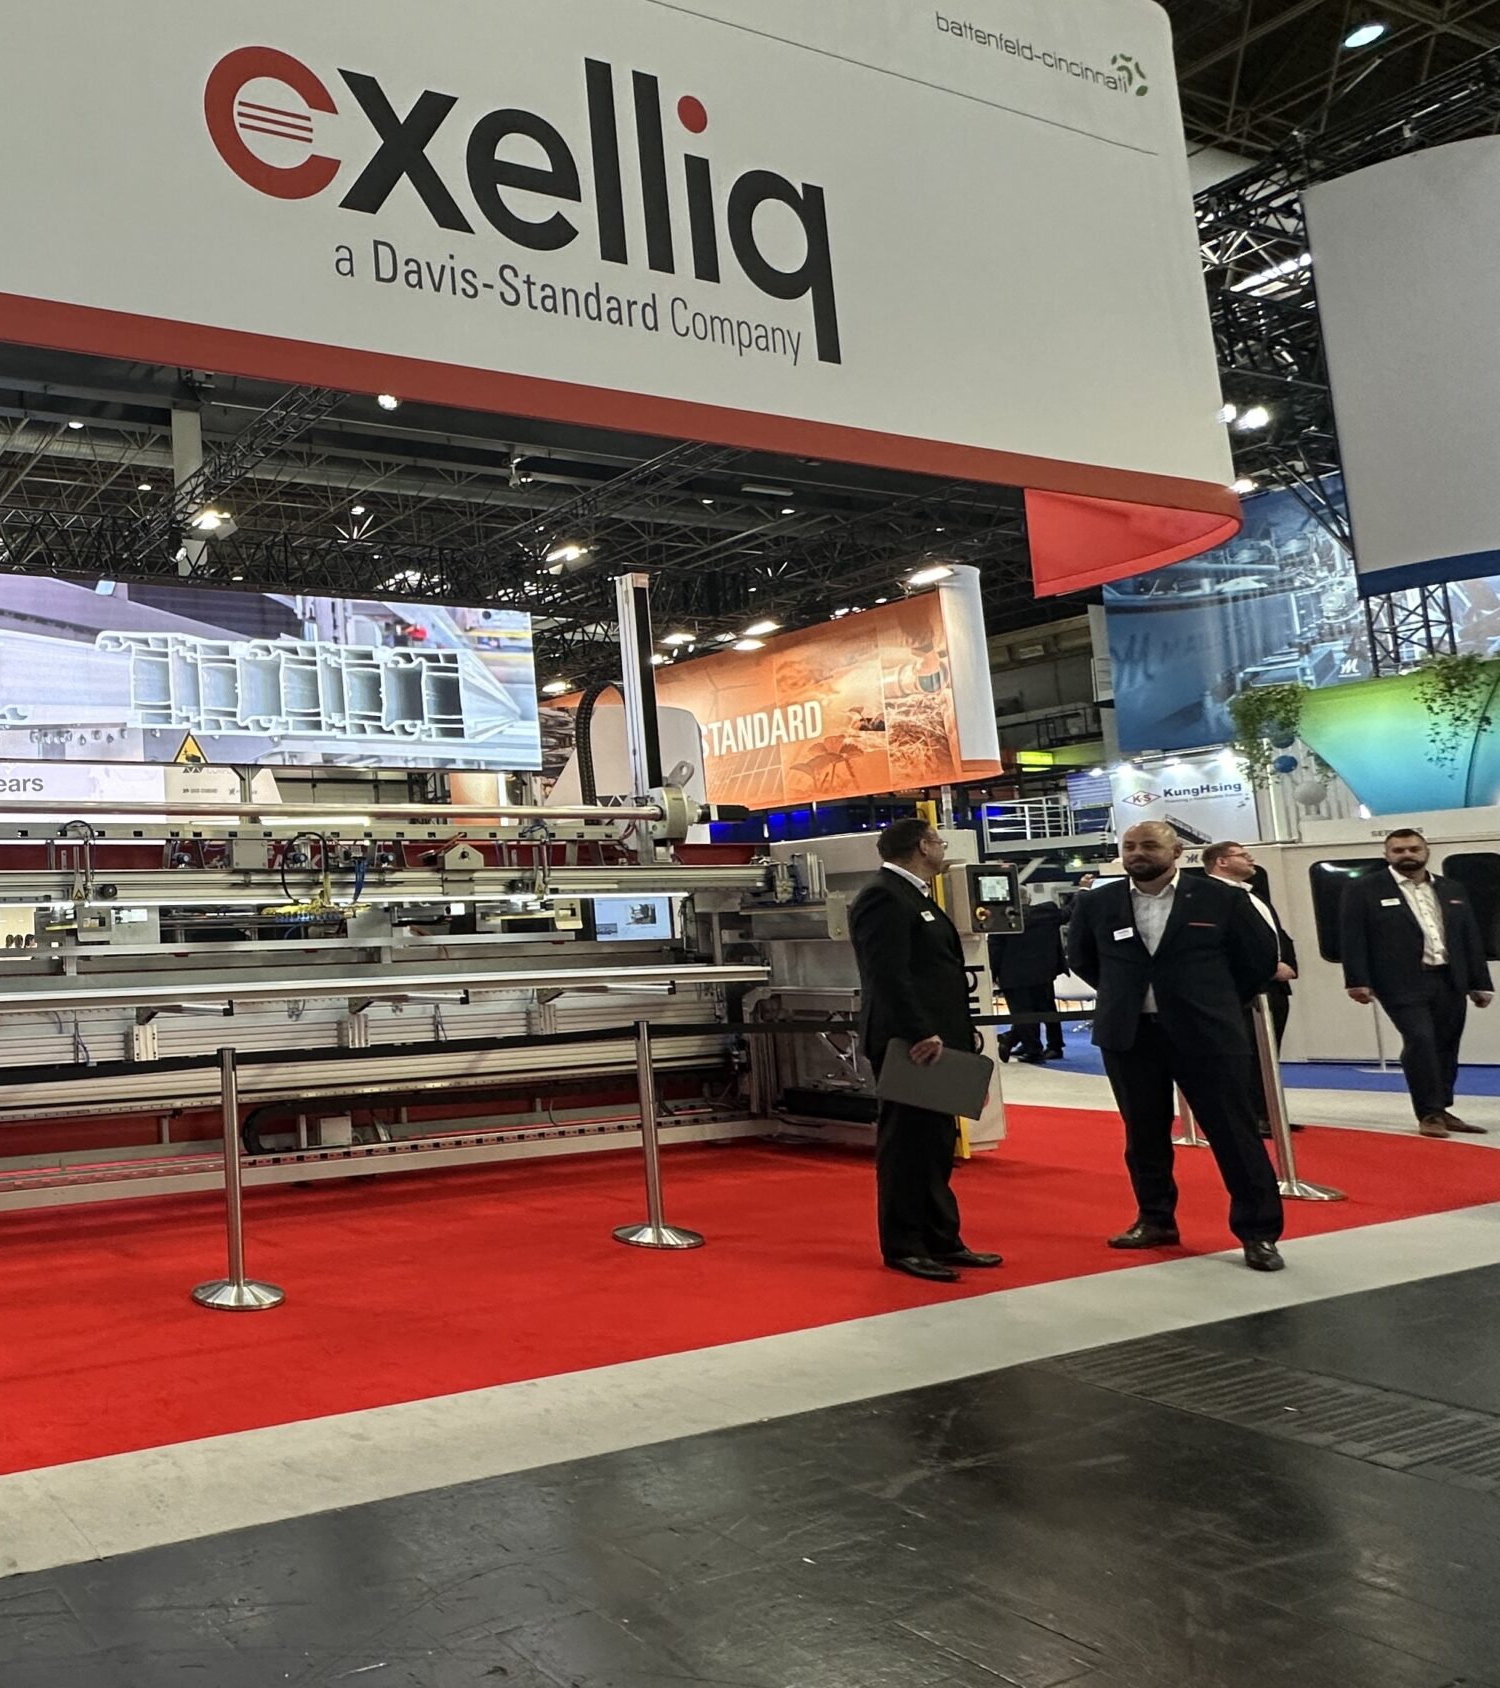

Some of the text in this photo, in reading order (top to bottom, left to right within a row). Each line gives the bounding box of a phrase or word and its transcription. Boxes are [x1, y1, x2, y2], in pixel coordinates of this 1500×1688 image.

[935, 10, 1128, 94] battenfeld-cincinnati
[203, 45, 842, 365] exelliq
[334, 239, 803, 367] a Davis-Standard Company
[1163, 782, 1242, 797] KungHsing
